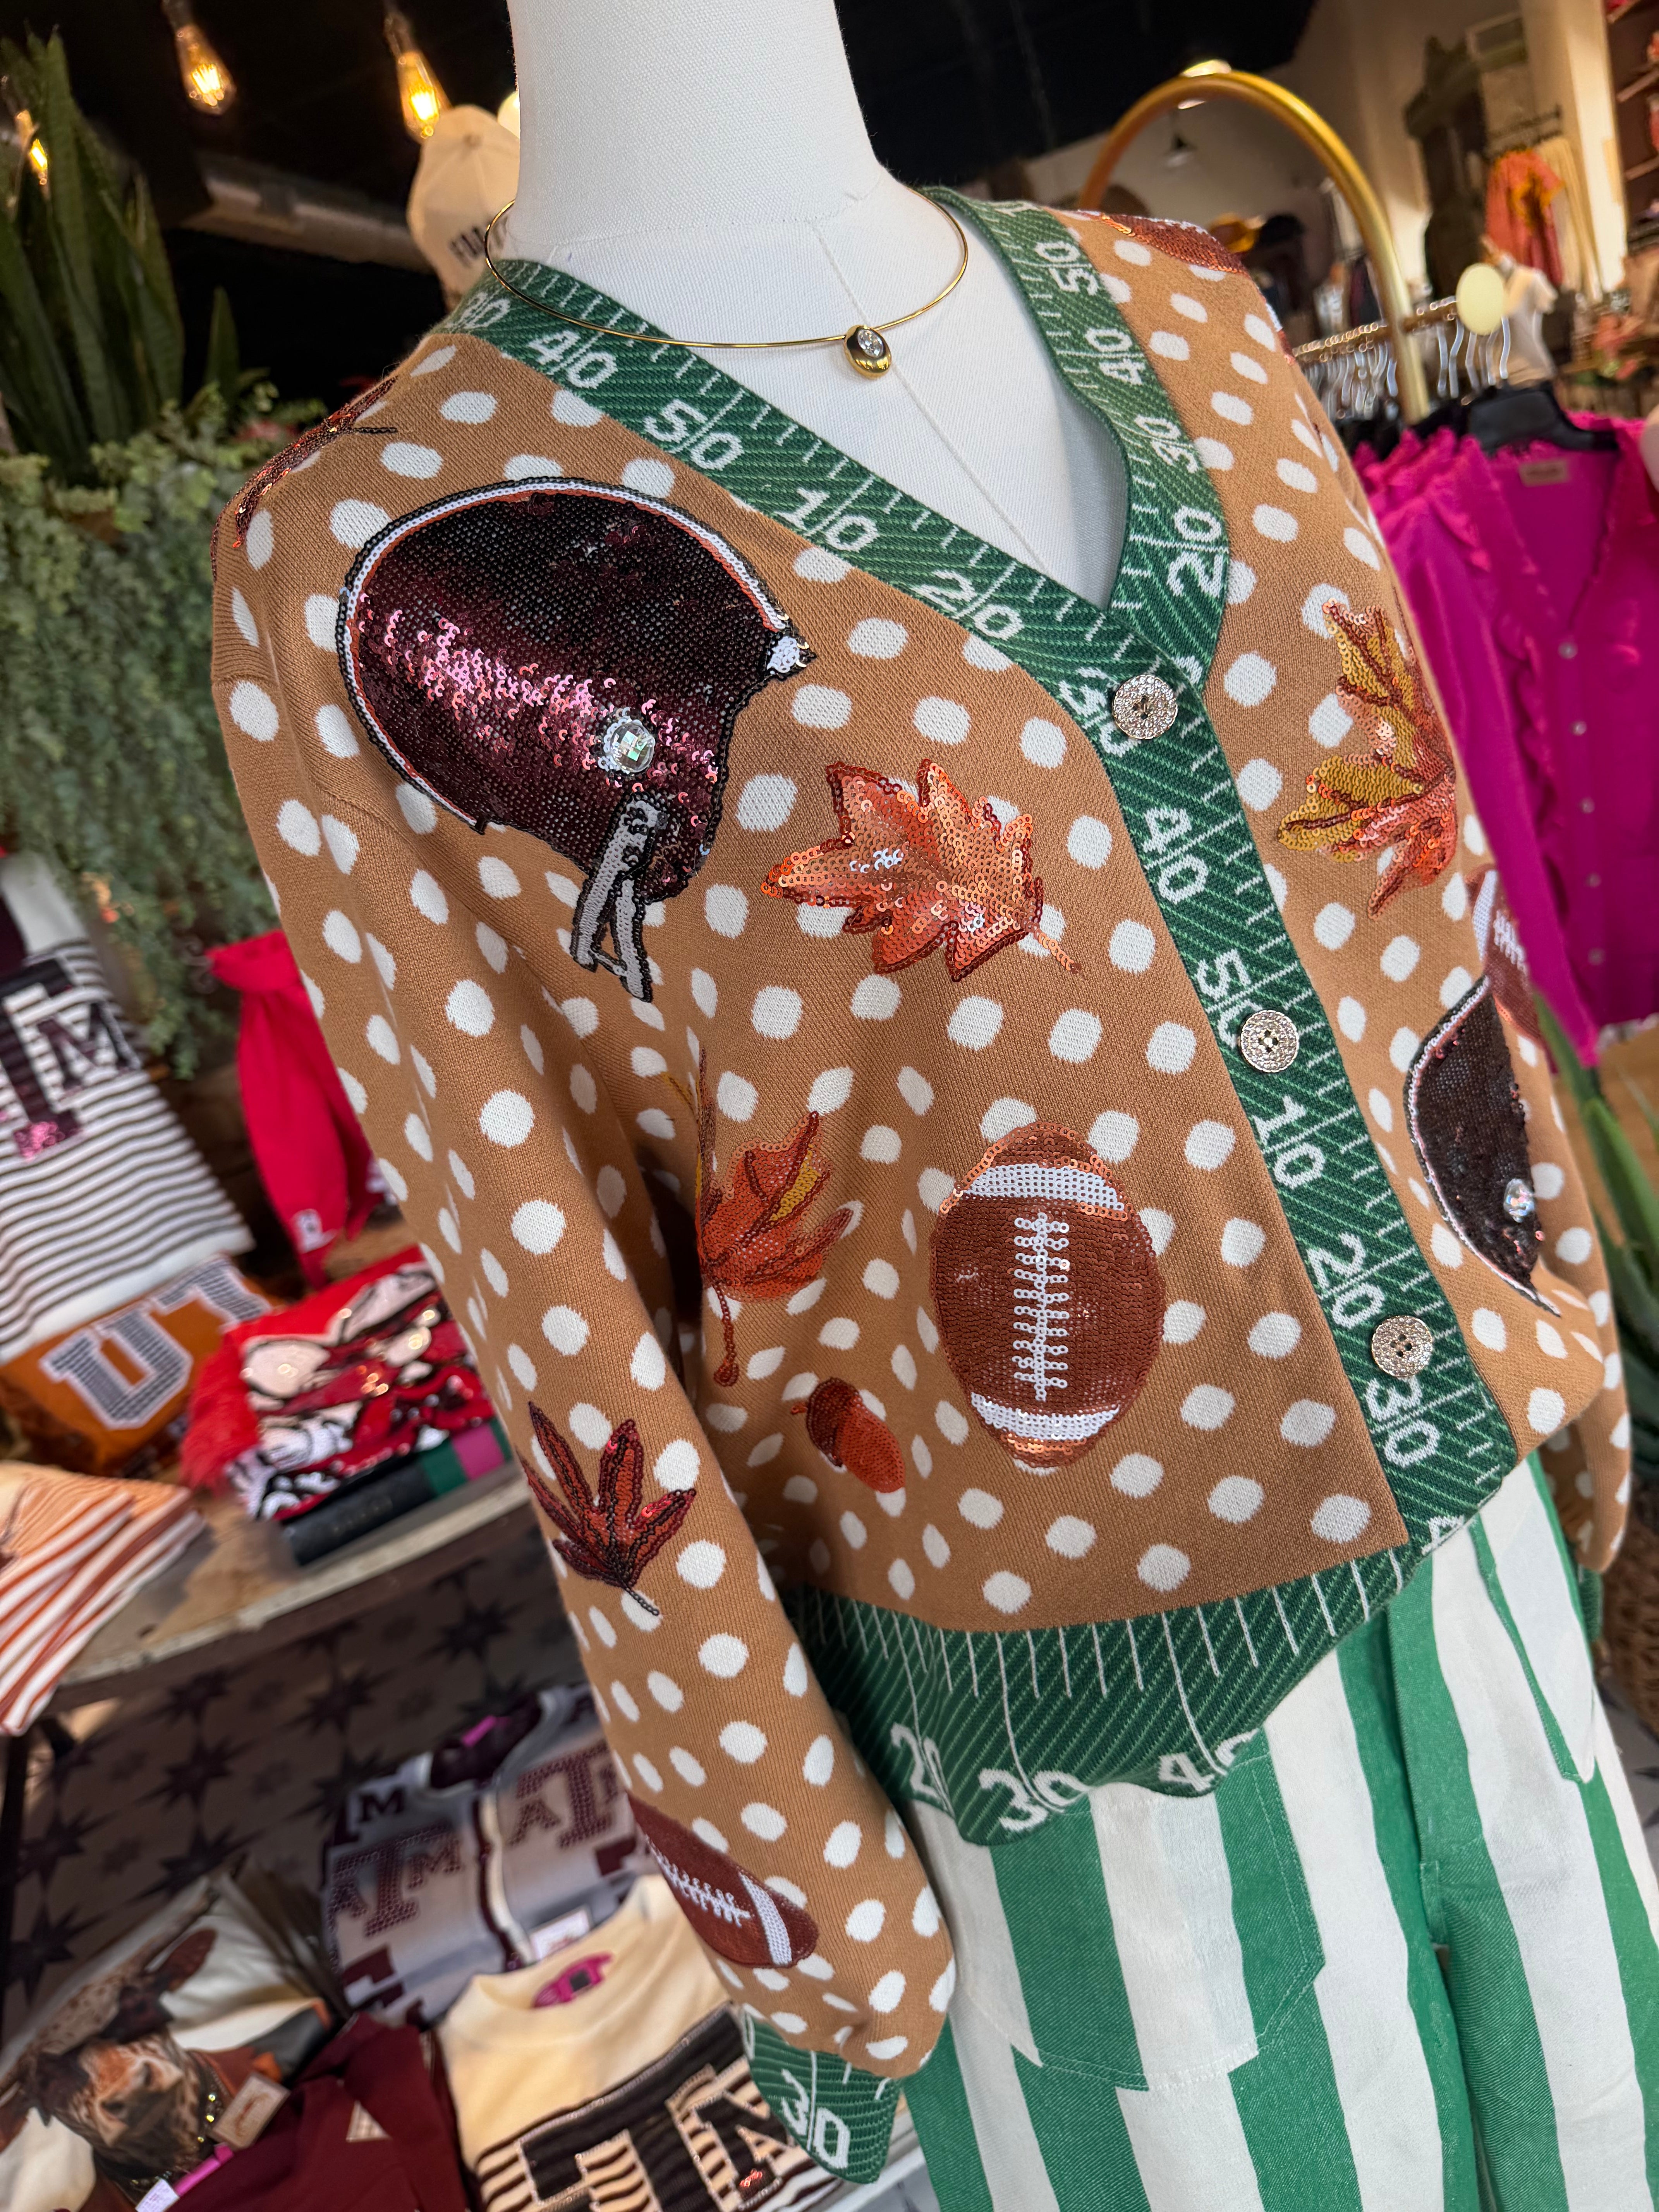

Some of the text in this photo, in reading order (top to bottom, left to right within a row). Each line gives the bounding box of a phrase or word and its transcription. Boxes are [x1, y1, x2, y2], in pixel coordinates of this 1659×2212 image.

[1034, 241, 1099, 296] 50
[527, 330, 617, 389] 40
[1086, 327, 1147, 385] 40
[644, 400, 744, 470] 50
[1134, 415, 1199, 473] 30
[776, 488, 880, 552] 10
[1166, 505, 1225, 598] 20
[912, 570, 1023, 640] 20
[1143, 807, 1208, 904] 40
[1251, 1096, 1325, 1188] 10
[1307, 1232, 1386, 1329] 20
[1365, 1376, 1440, 1468] 30
[979, 1767, 1090, 1832] 30
[780, 2068, 851, 2169] 30
